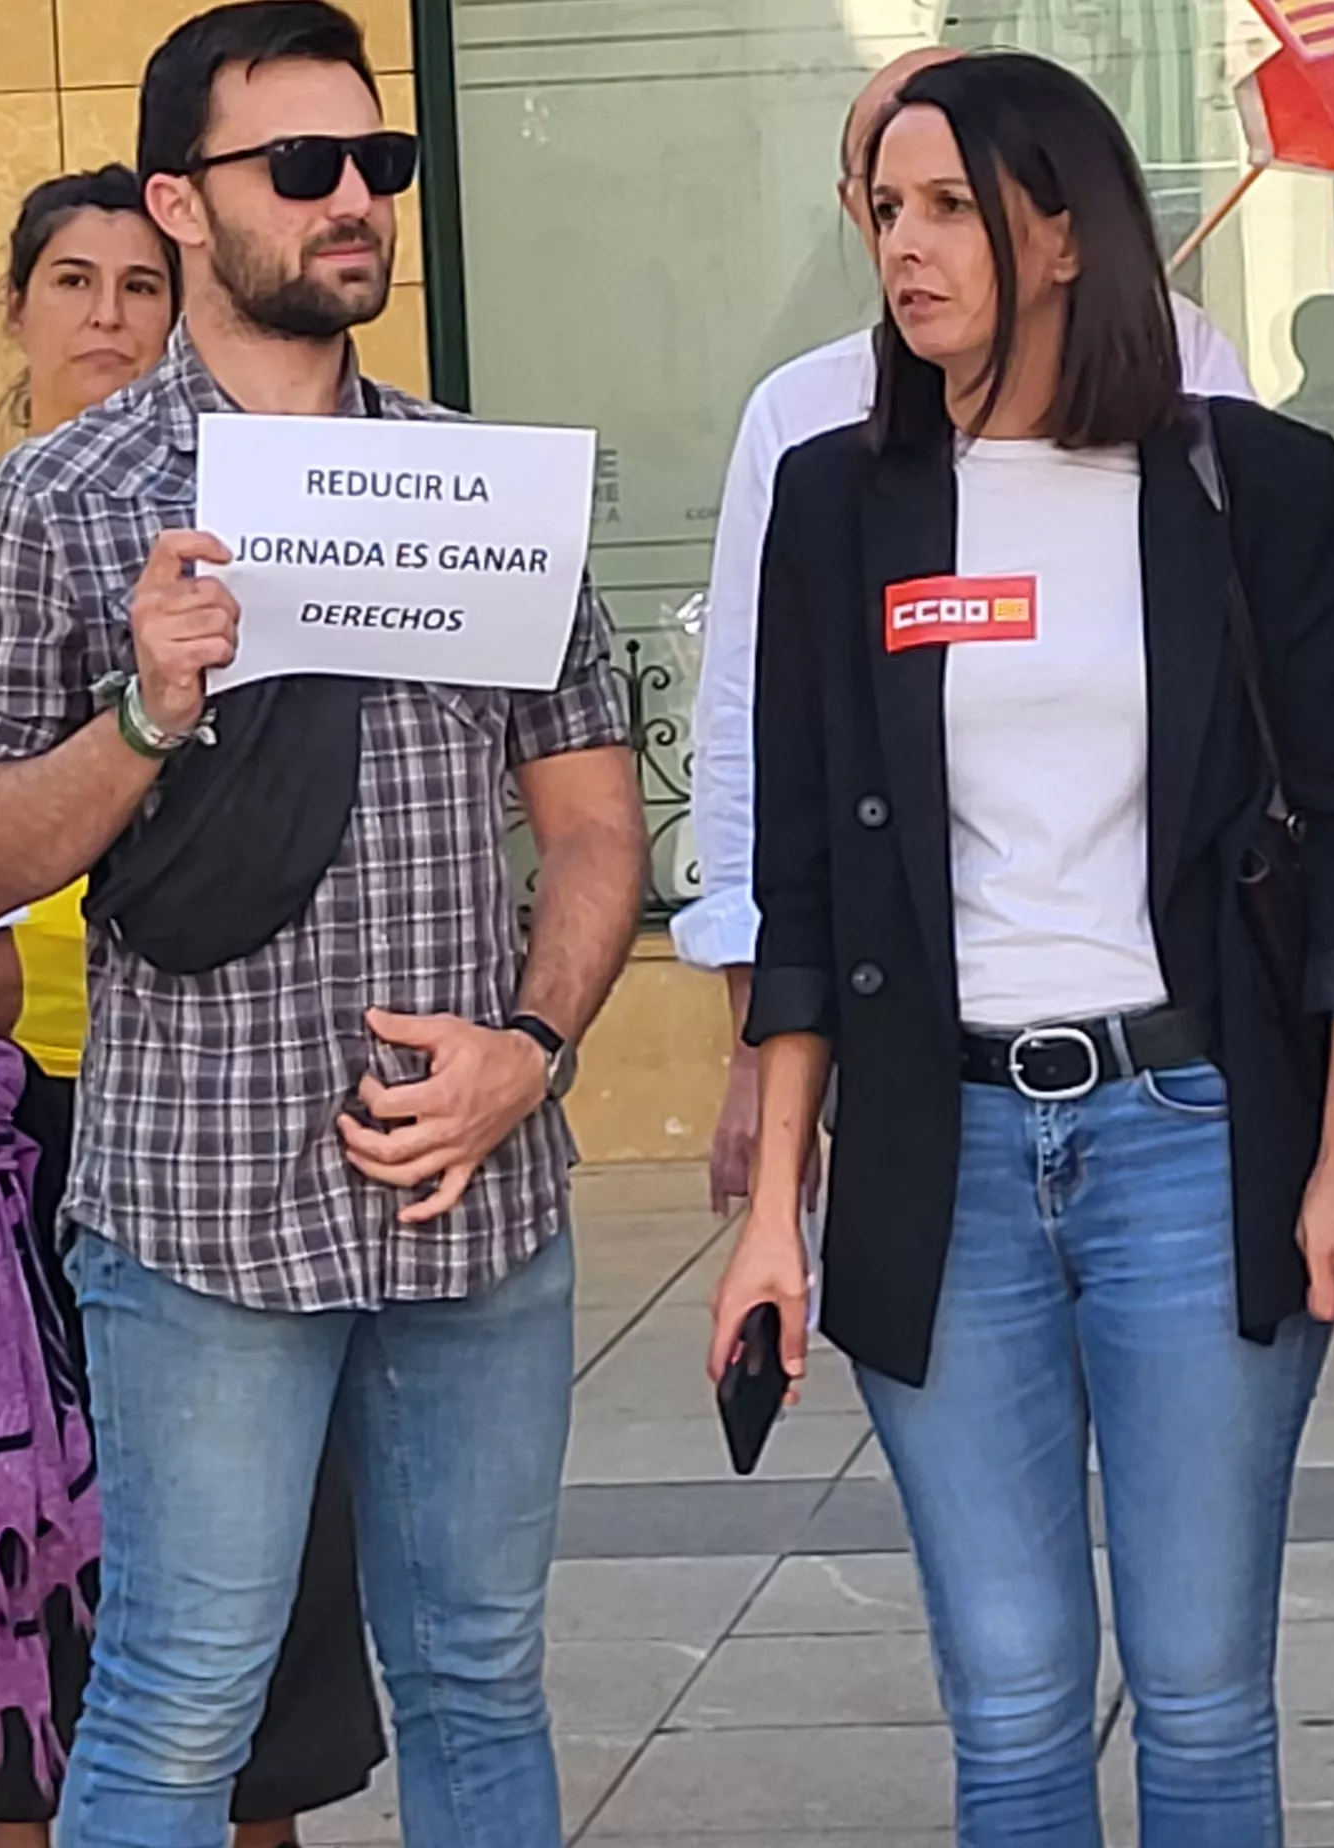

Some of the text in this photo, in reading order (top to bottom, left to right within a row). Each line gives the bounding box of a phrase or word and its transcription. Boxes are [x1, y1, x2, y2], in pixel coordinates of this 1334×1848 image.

[307, 469, 489, 503] REDUCIR LA
[238, 536, 549, 574] JORNADA ES GANAR
[299, 602, 465, 633] DERECHOS
[892, 598, 990, 630] CCOO
